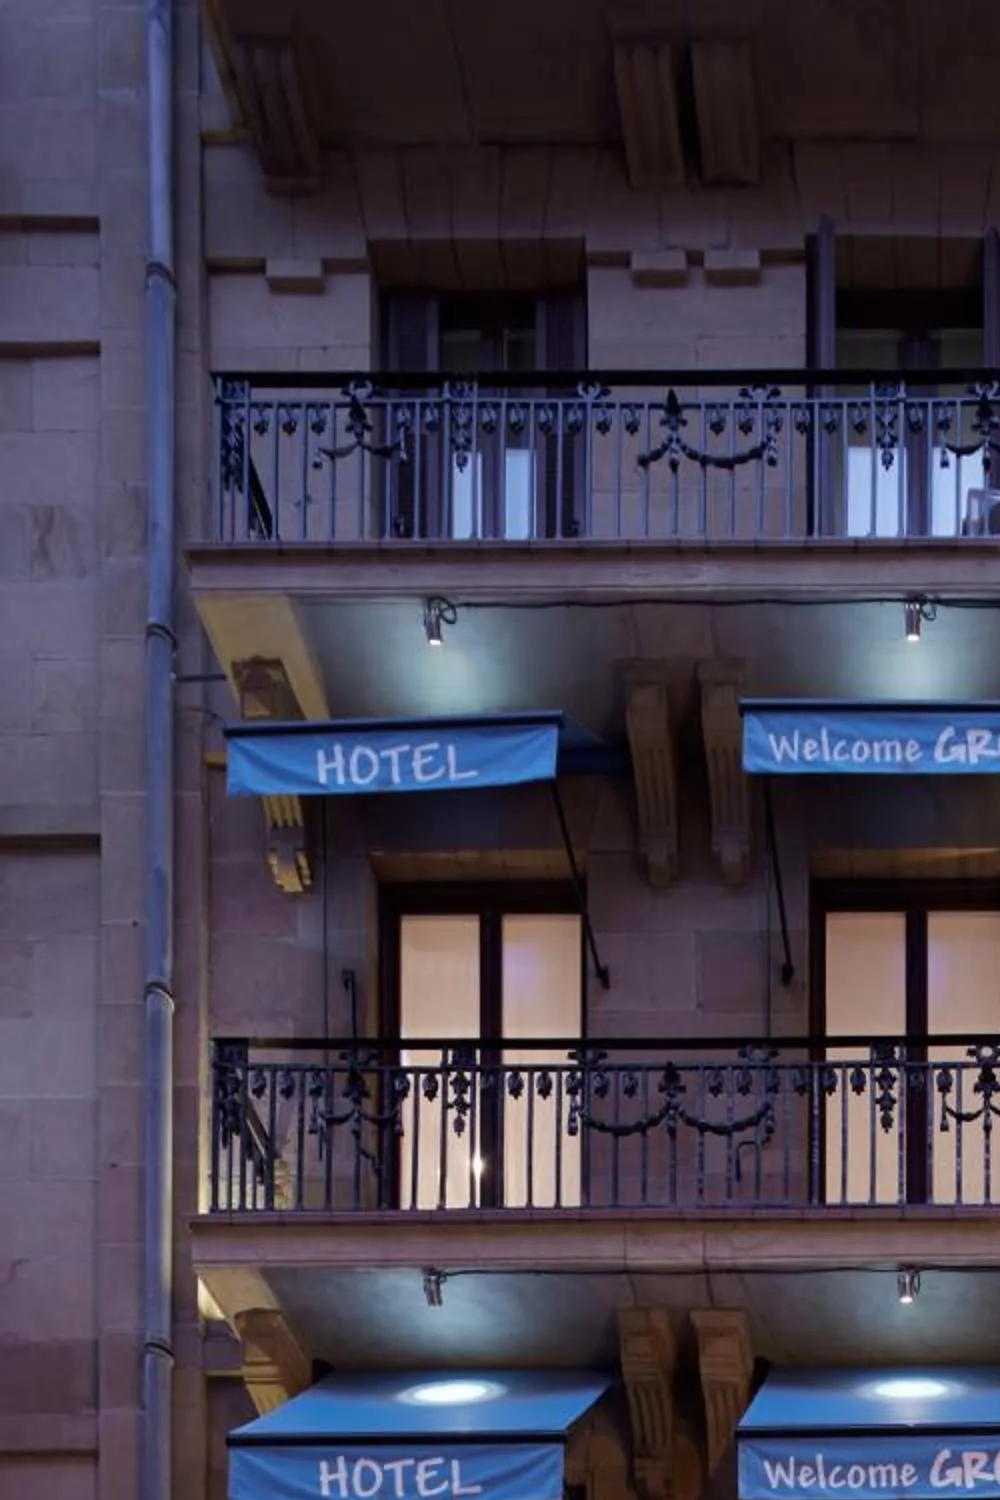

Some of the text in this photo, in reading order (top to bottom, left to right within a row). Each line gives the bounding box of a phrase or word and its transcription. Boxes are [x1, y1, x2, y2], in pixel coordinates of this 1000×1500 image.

[316, 742, 479, 786] HOTEL
[768, 727, 923, 764] Welcome
[319, 1456, 481, 1498] HOTEL
[763, 1453, 918, 1489] Welcome
